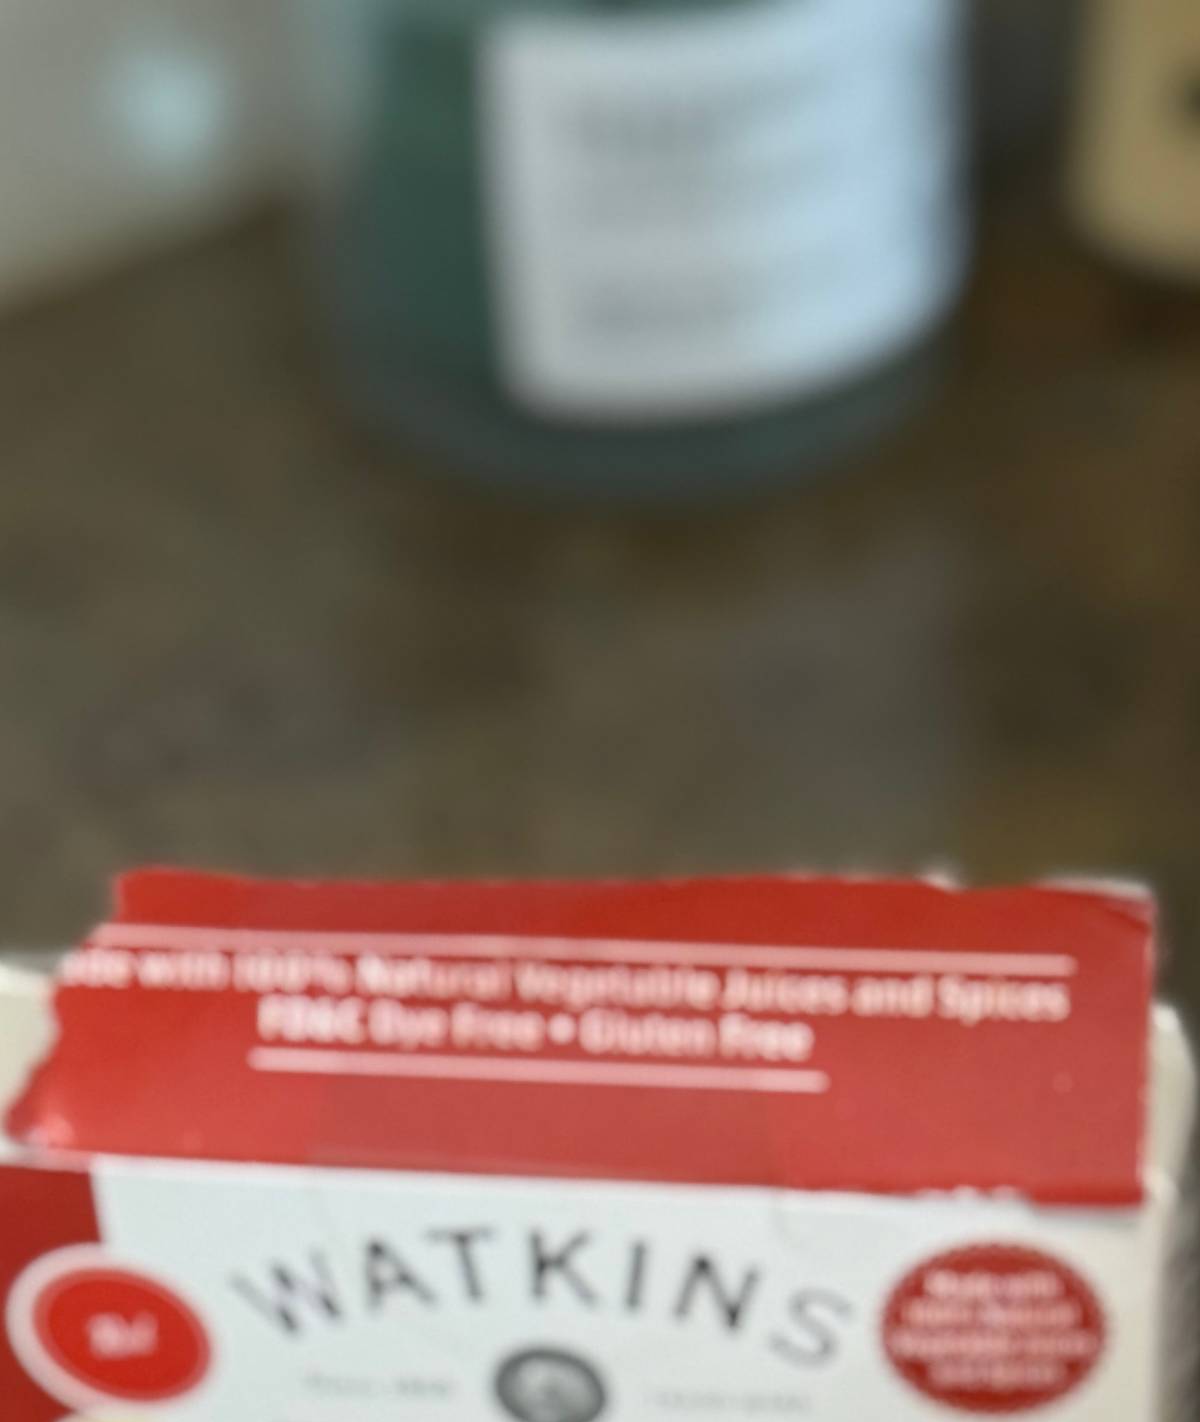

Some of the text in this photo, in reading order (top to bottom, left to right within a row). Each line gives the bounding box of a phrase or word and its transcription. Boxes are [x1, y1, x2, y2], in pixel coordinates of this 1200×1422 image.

[136, 949, 230, 992] with
[356, 951, 510, 1000] Natural
[514, 960, 720, 1012] Vegetable
[722, 967, 849, 1016] Juices
[851, 974, 935, 1019] and
[936, 973, 1072, 1027] Spices
[367, 999, 448, 1052] Dye
[450, 1003, 544, 1053] Free
[577, 1006, 717, 1058] Gluten
[718, 1011, 815, 1063] Free
[230, 1226, 852, 1368] WATKINS
